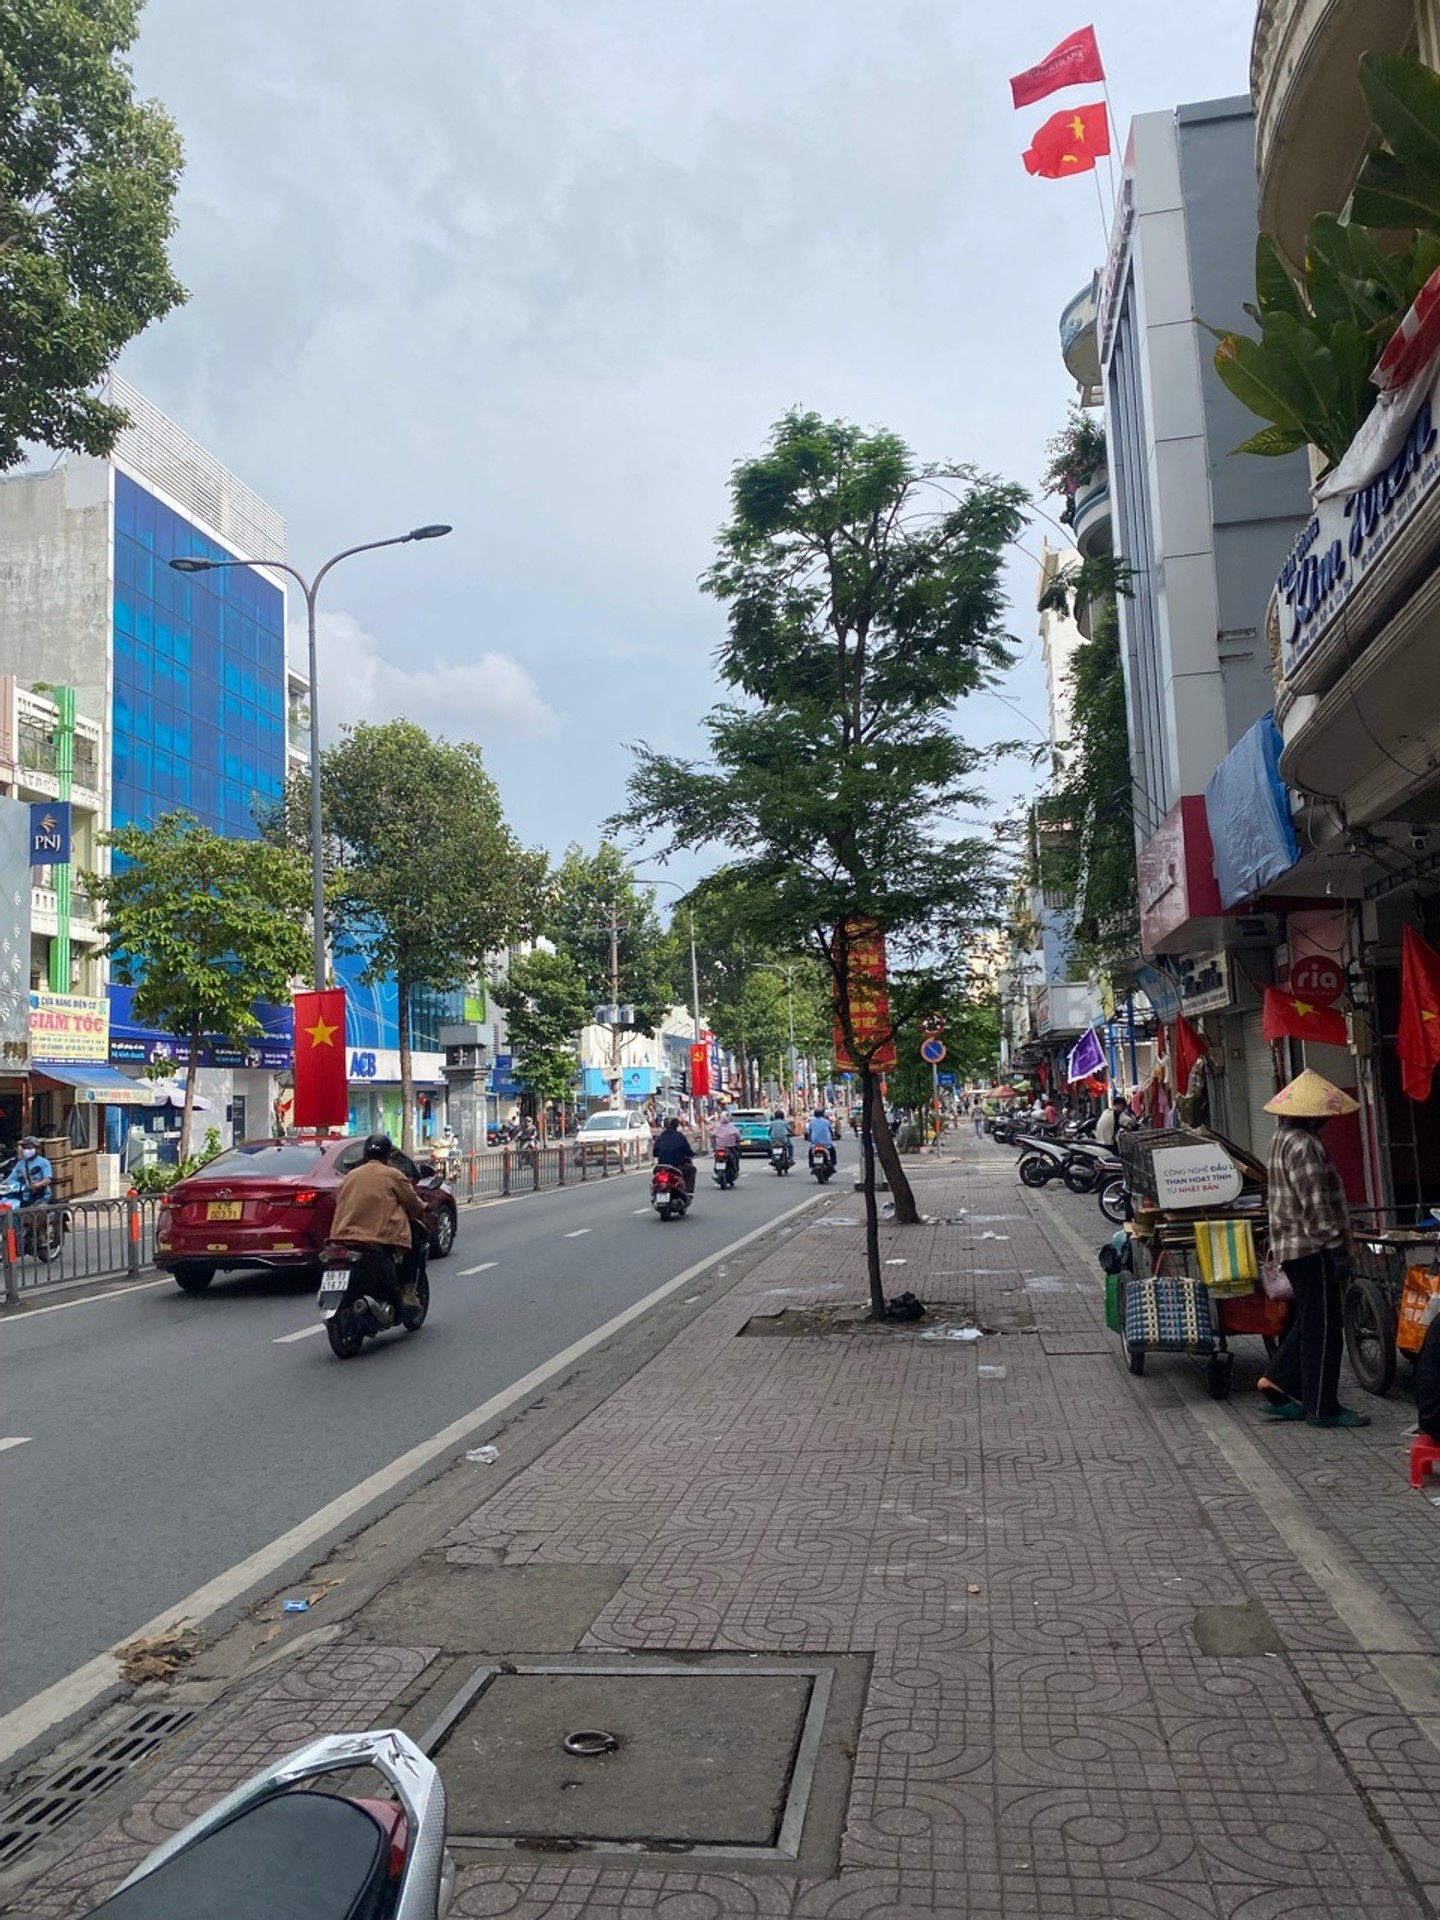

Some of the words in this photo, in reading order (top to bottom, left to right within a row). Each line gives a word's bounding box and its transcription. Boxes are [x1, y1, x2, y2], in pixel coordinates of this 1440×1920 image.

[35, 834, 61, 852] PNJ
[1297, 962, 1338, 989] ria
[350, 1052, 376, 1077] ACB
[1164, 1167, 1186, 1177] CÔNG
[1165, 1178, 1187, 1186] THAN
